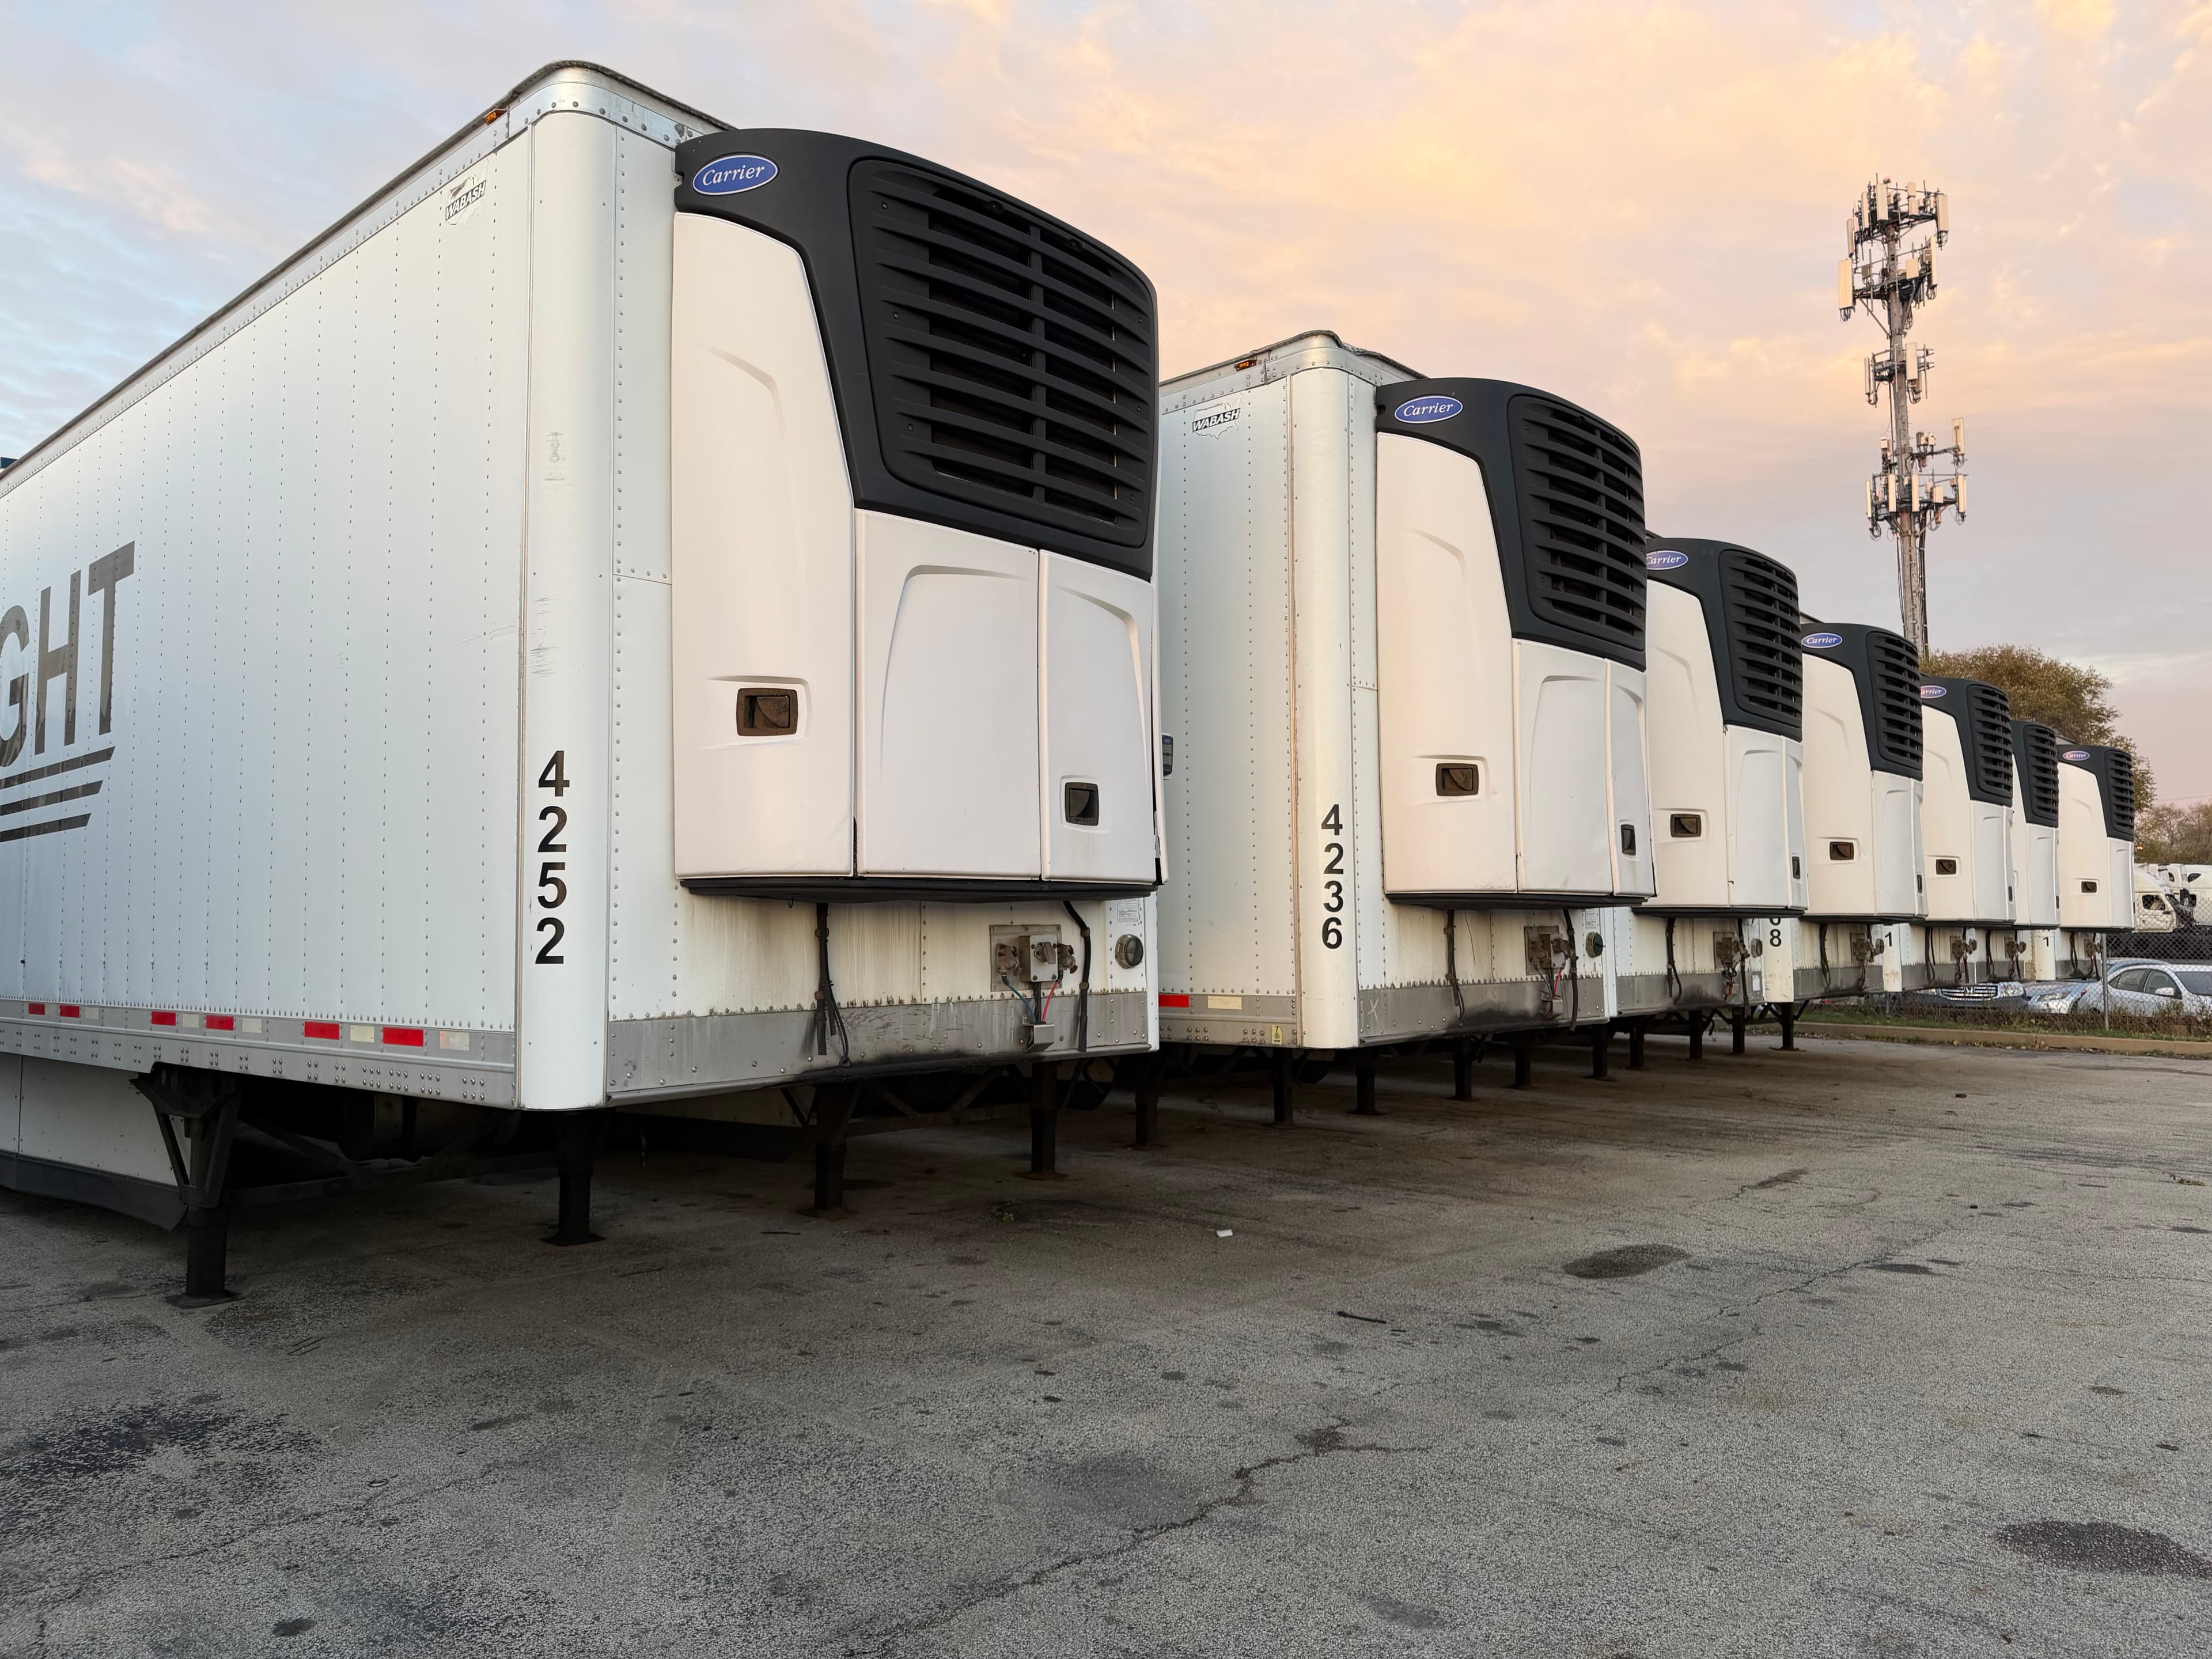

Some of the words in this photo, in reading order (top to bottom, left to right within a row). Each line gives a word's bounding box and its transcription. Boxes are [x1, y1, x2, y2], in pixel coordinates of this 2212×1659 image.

[702, 165, 765, 185] Carrier
[446, 181, 486, 219] WABASH
[1193, 409, 1240, 431] WABASH
[1403, 403, 1453, 416] Carrier
[535, 750, 570, 964] 4252
[1321, 804, 1344, 949] 4236
